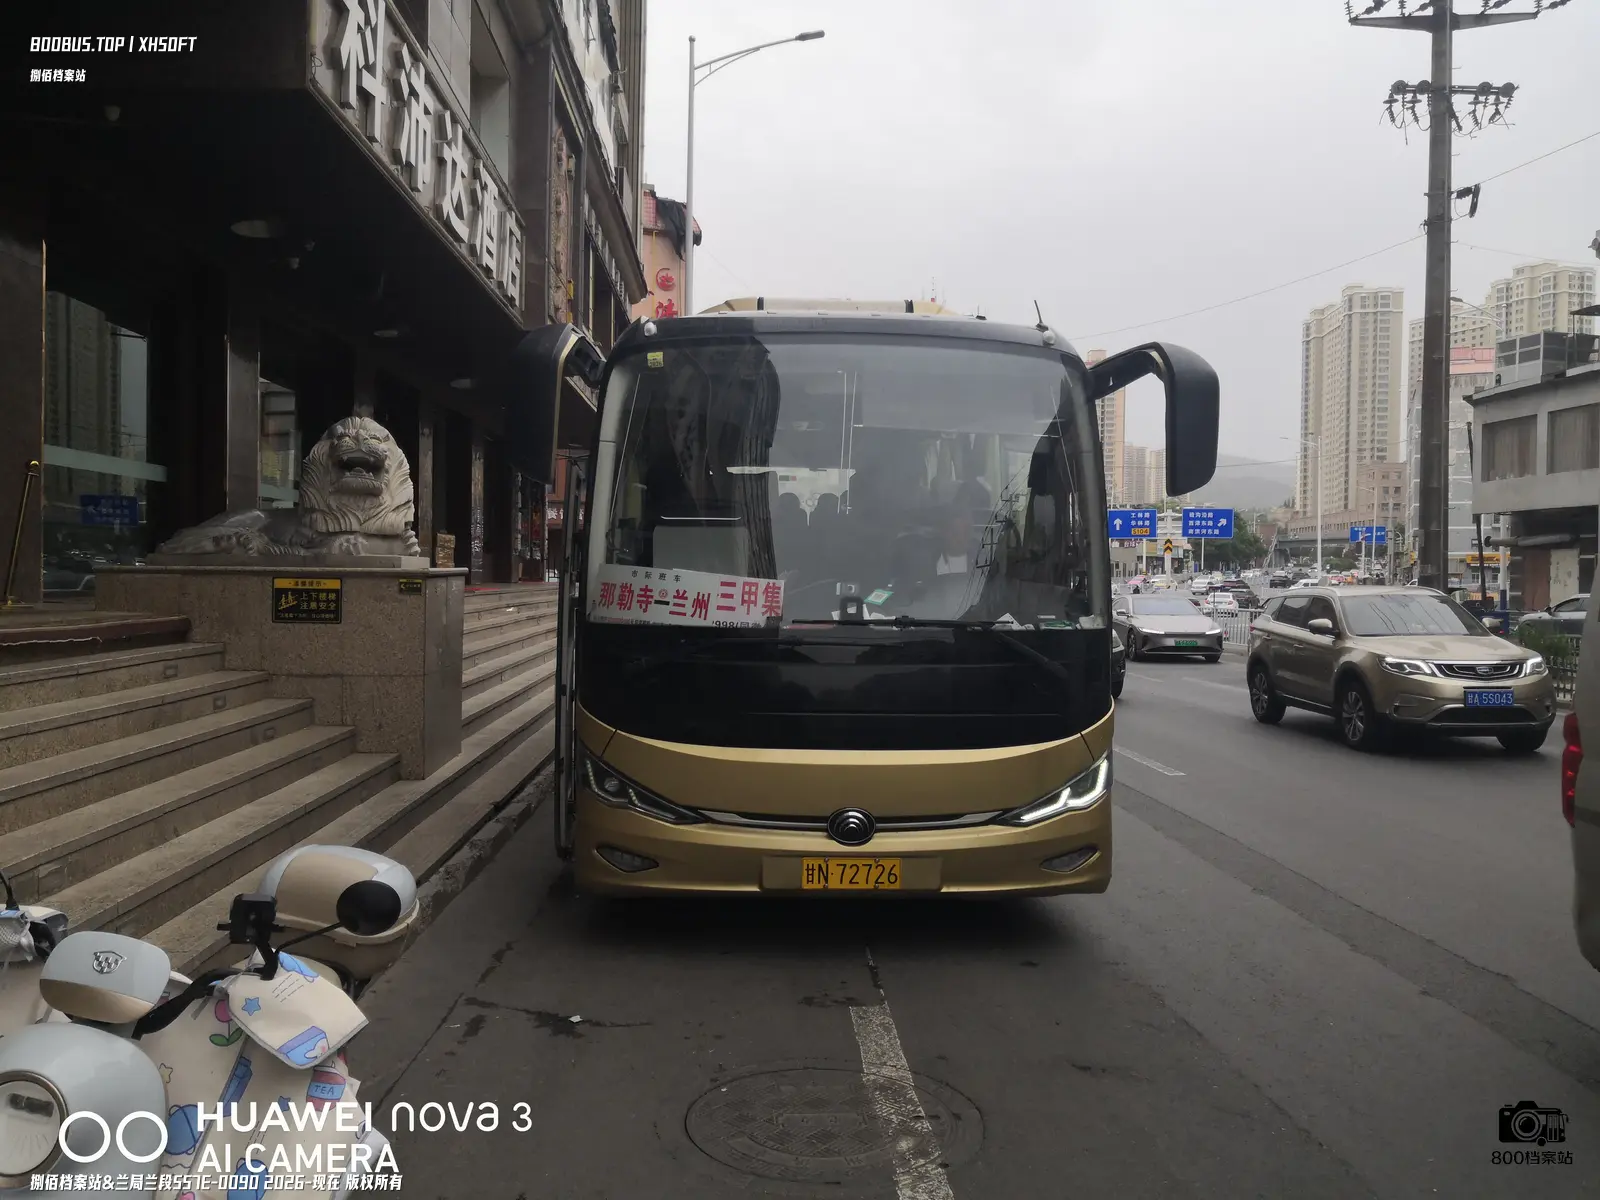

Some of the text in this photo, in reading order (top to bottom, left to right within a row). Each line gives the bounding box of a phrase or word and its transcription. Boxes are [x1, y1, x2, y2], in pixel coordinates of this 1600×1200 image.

[340, 0, 521, 309] 科沛达酒店
[631, 569, 682, 583] 市际班车
[300, 591, 336, 601] 上下楼梯
[716, 581, 782, 617] 三甲集
[300, 601, 336, 610] 注意安全
[314, 1084, 335, 1096] TEA
